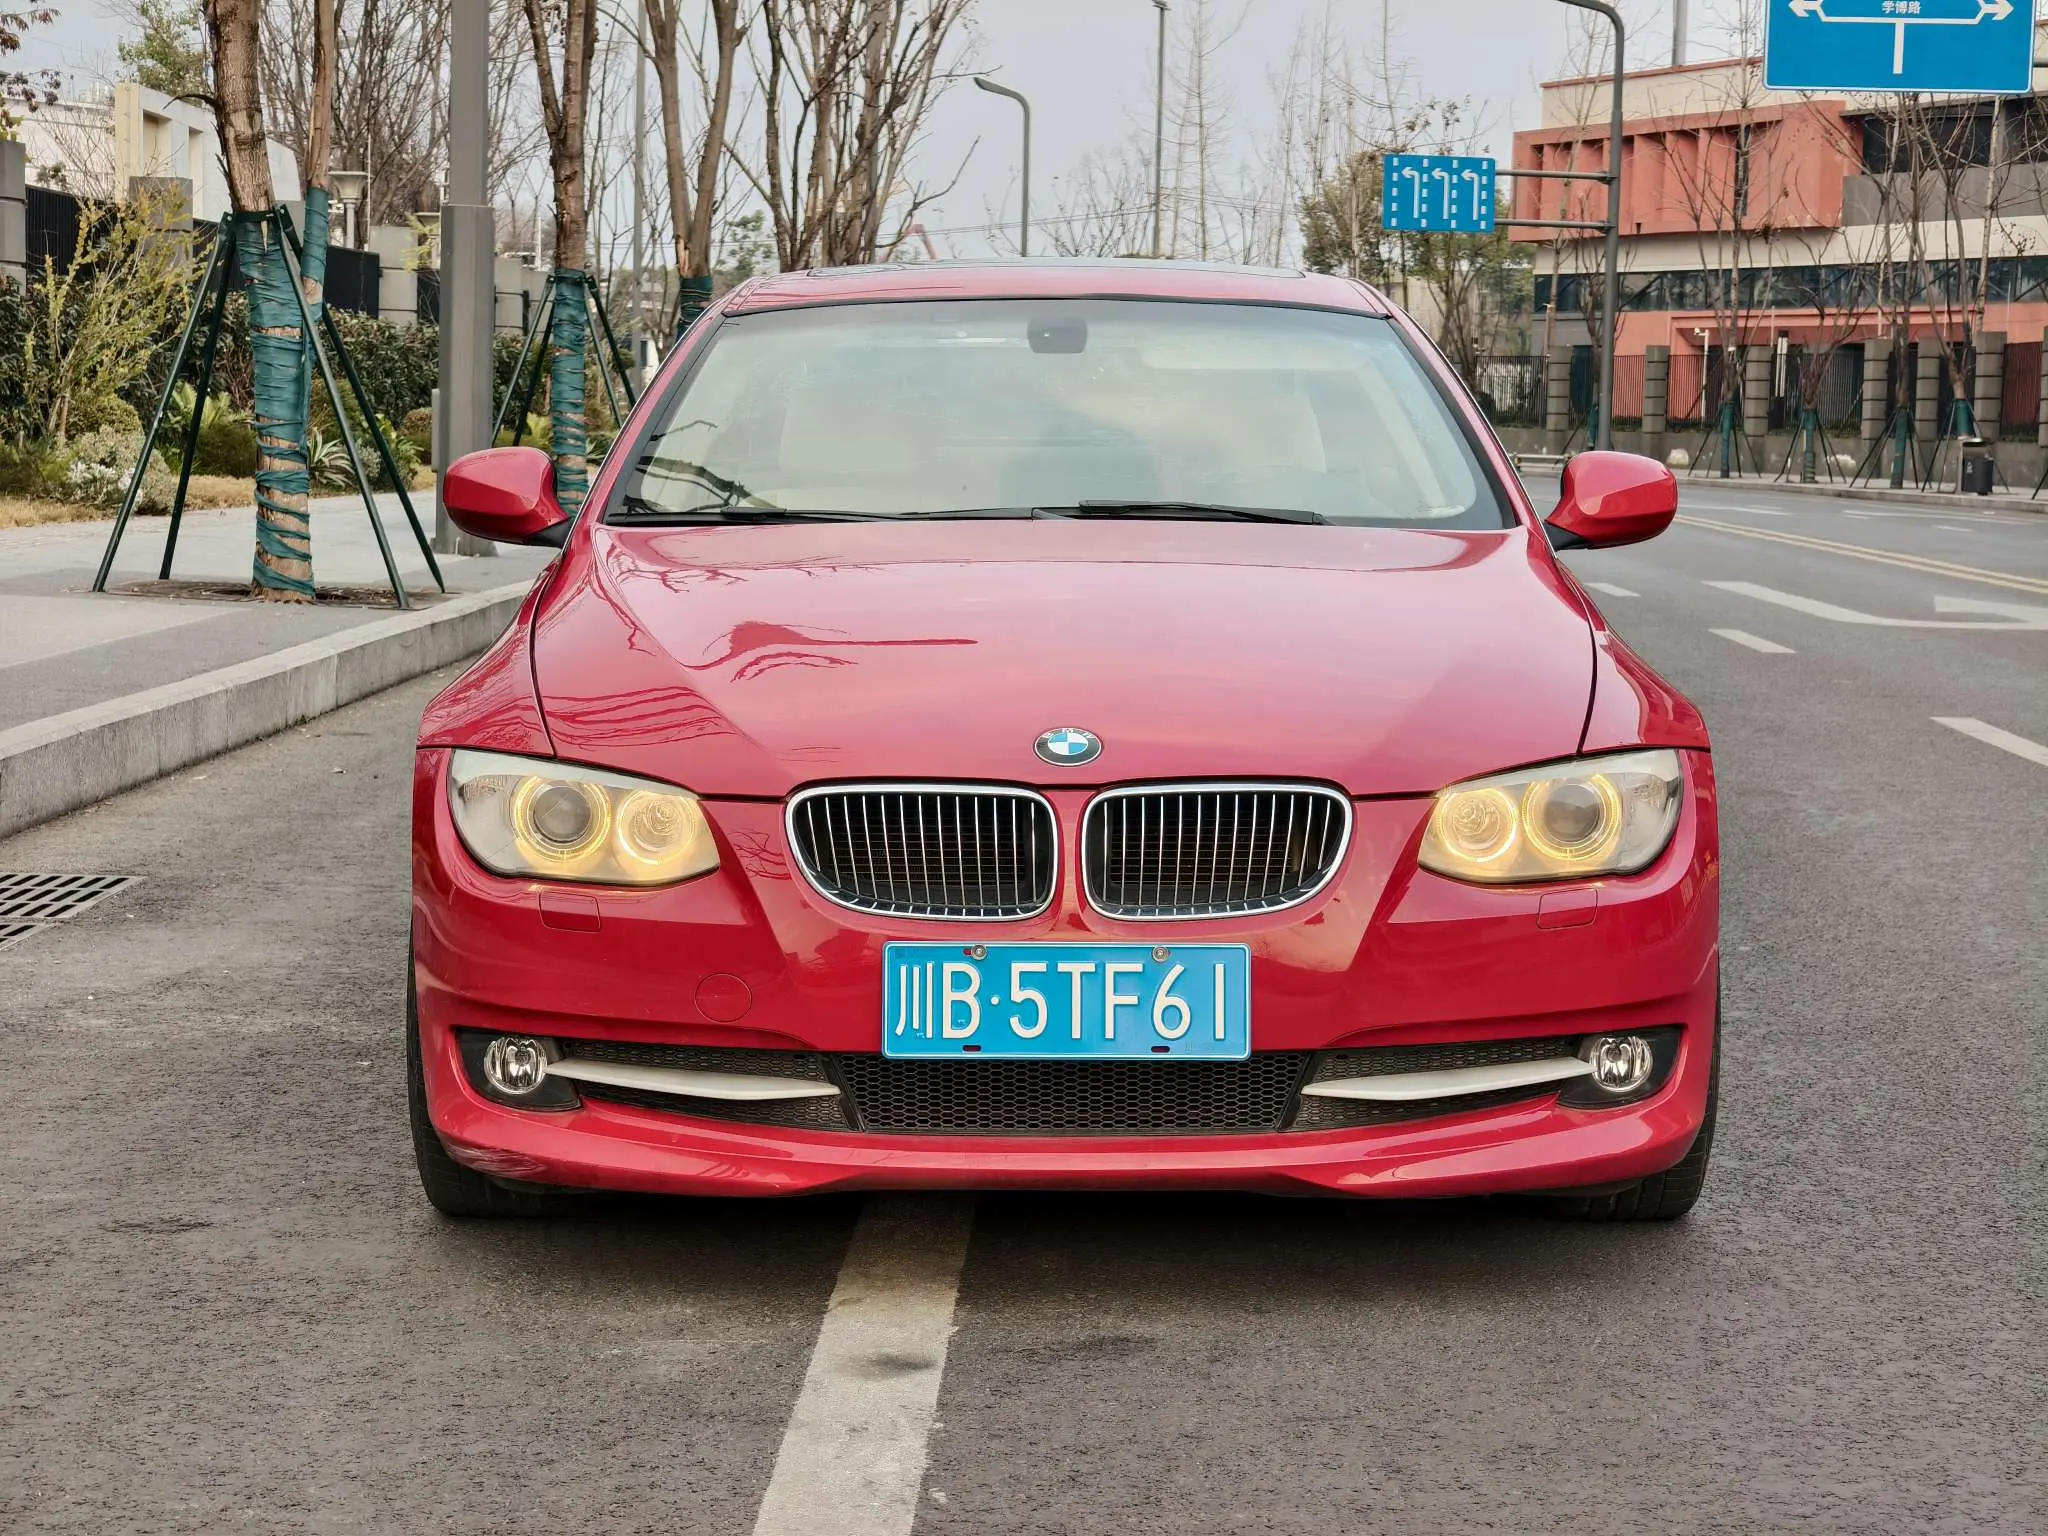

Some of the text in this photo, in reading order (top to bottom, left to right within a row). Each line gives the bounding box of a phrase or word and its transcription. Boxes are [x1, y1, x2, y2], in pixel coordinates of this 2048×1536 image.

[1882, 0, 1921, 14] 学博路
[894, 961, 1226, 1040] 川B·5TF61
